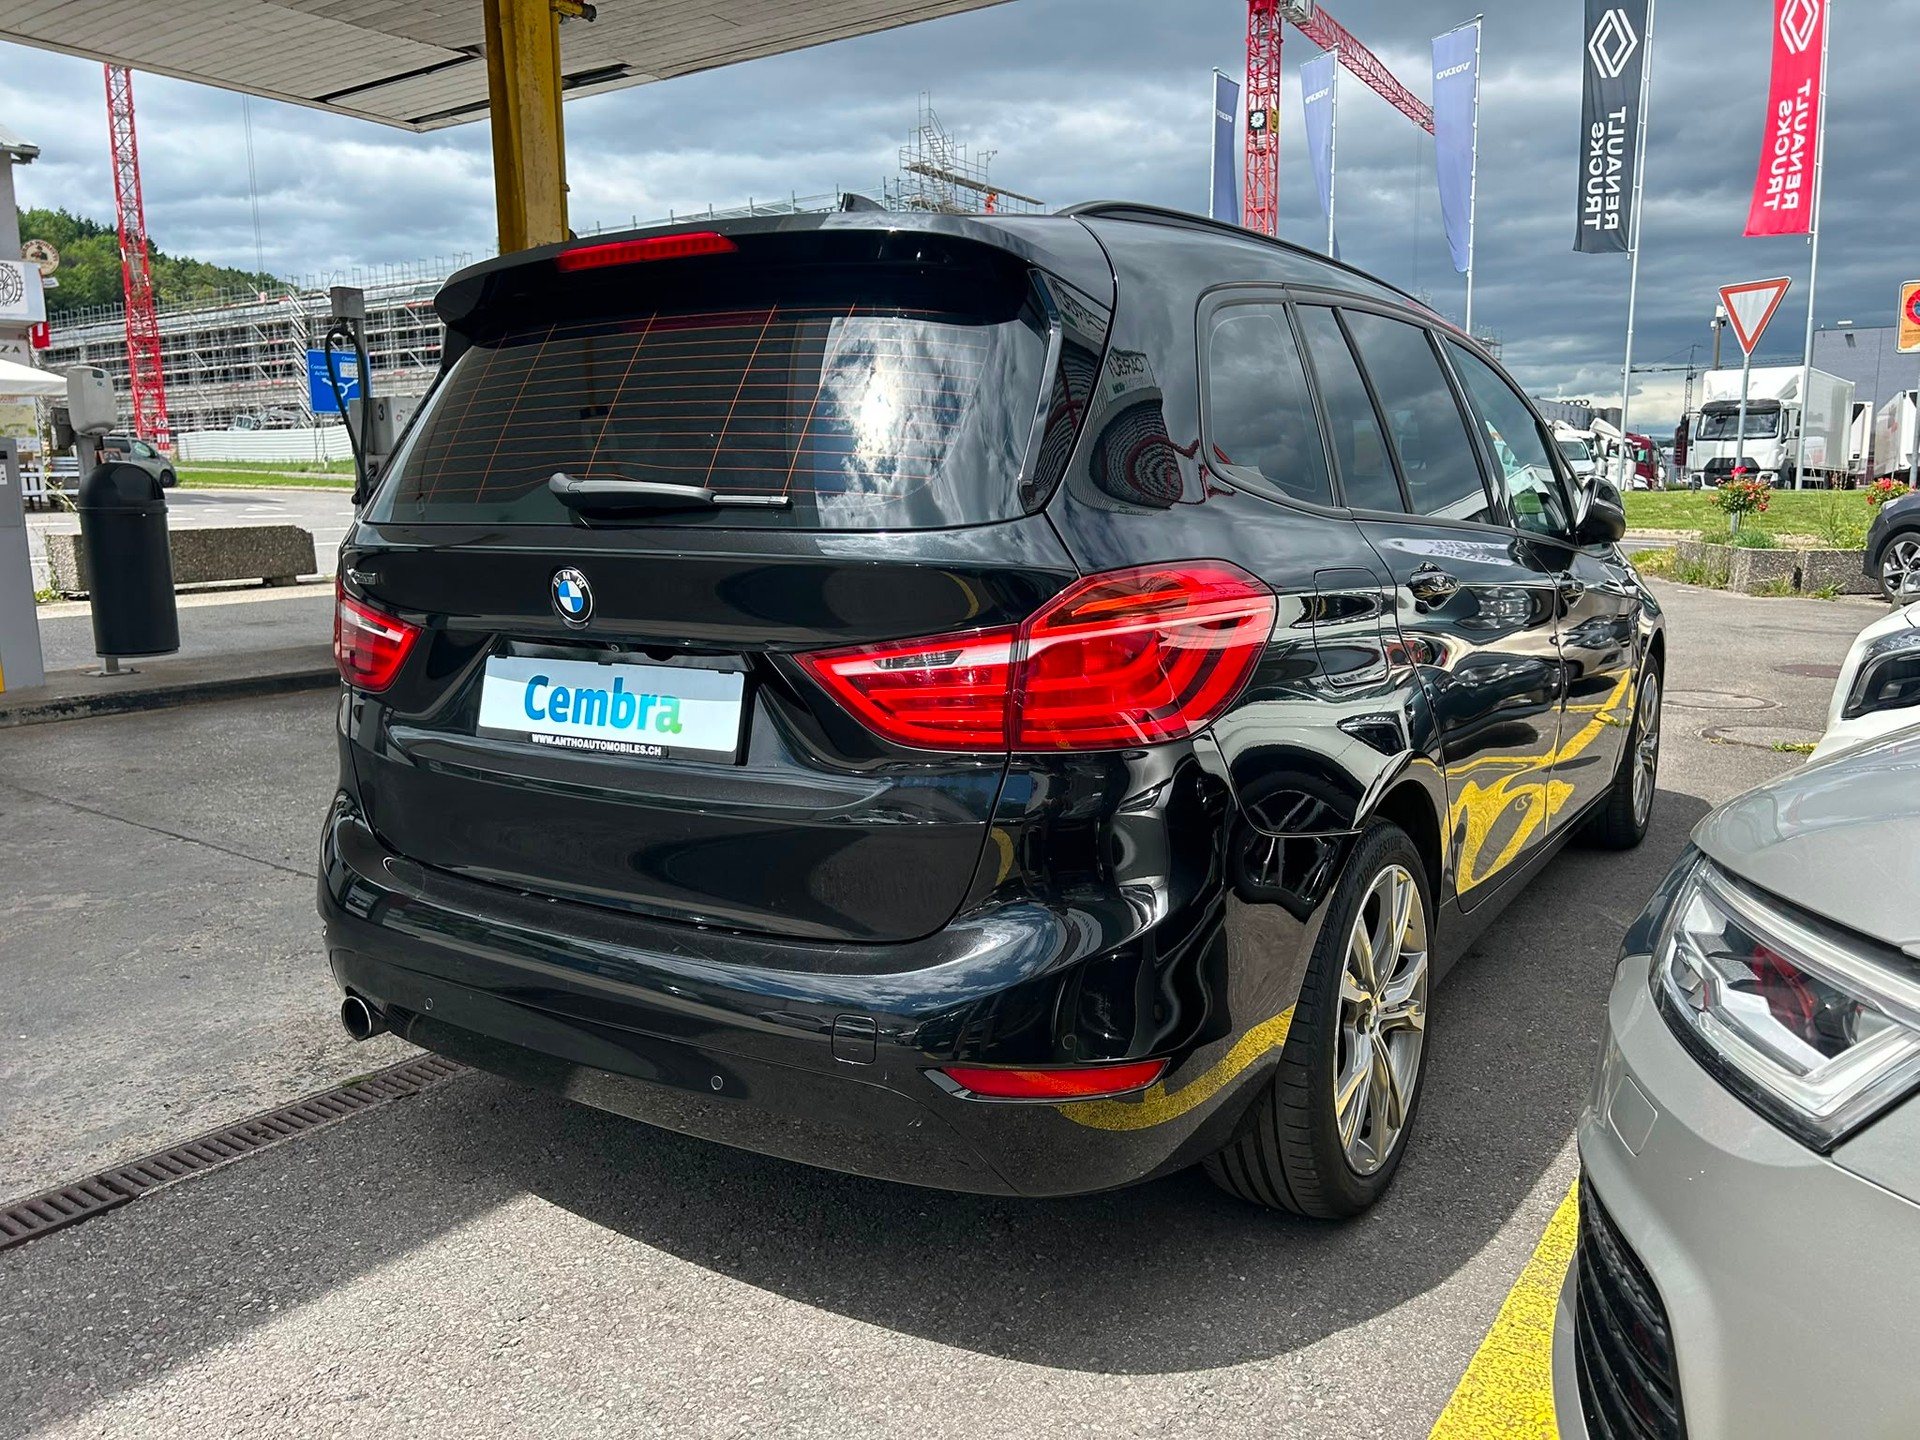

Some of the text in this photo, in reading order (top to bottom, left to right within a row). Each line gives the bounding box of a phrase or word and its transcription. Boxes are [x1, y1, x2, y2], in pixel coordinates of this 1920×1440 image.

[378, 403, 385, 421] 3
[553, 571, 585, 589] BMW
[524, 674, 683, 735] Cembra
[531, 733, 662, 756] WWW.ANTHOAUTOMOBILES.CH
